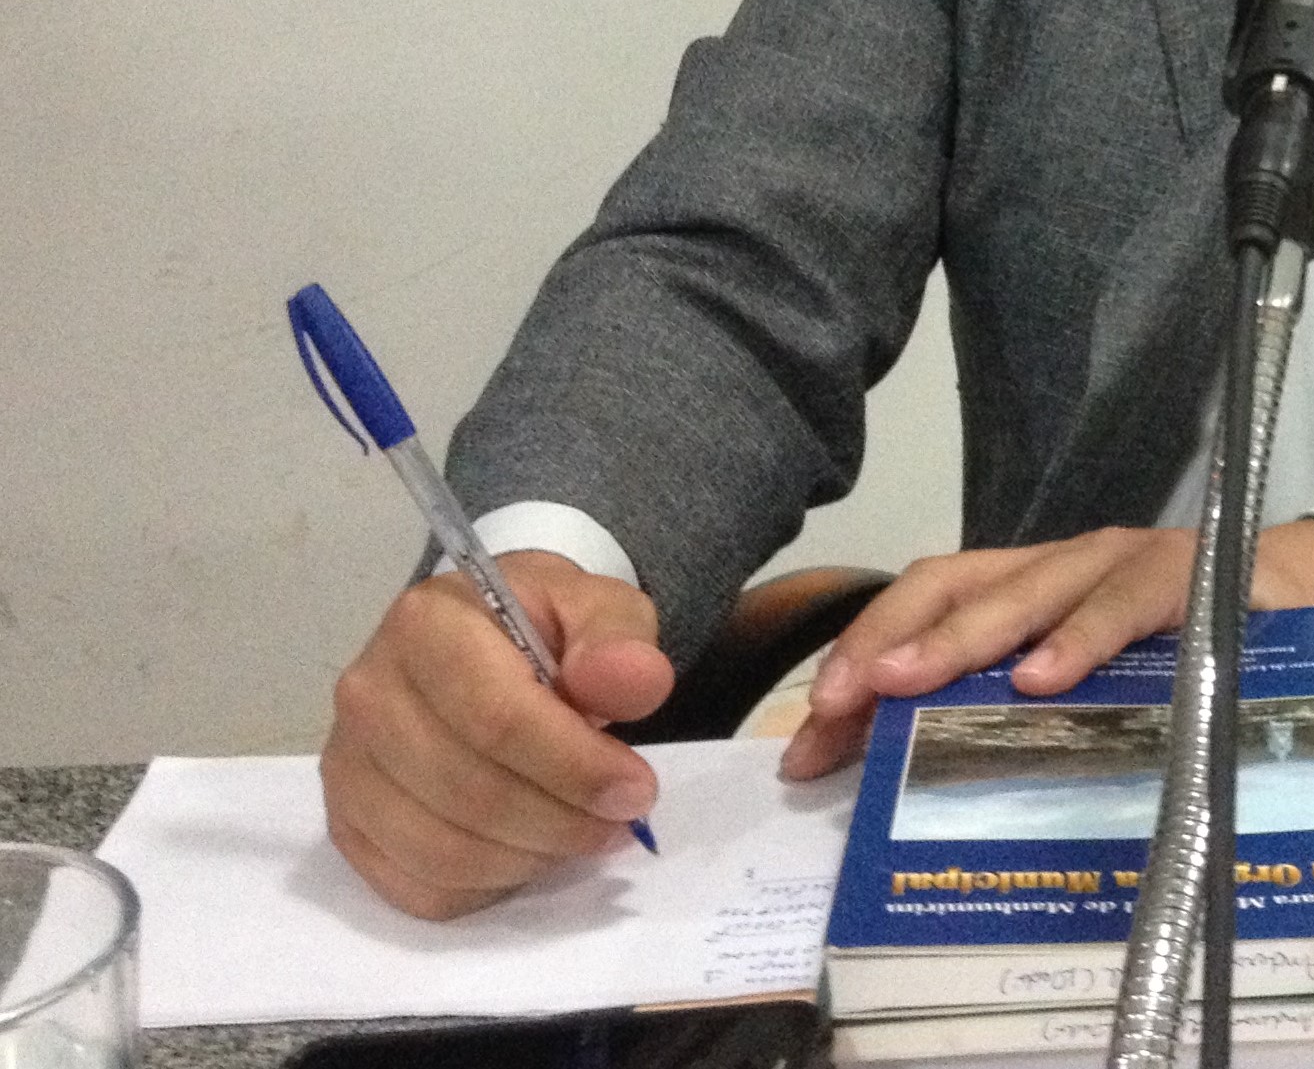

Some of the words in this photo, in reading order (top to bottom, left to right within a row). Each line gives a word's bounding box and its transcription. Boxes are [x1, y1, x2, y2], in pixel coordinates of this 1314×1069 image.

[891, 867, 1102, 896] Municipal
[885, 901, 1076, 916] Manhumirim
[1081, 900, 1117, 914] de
